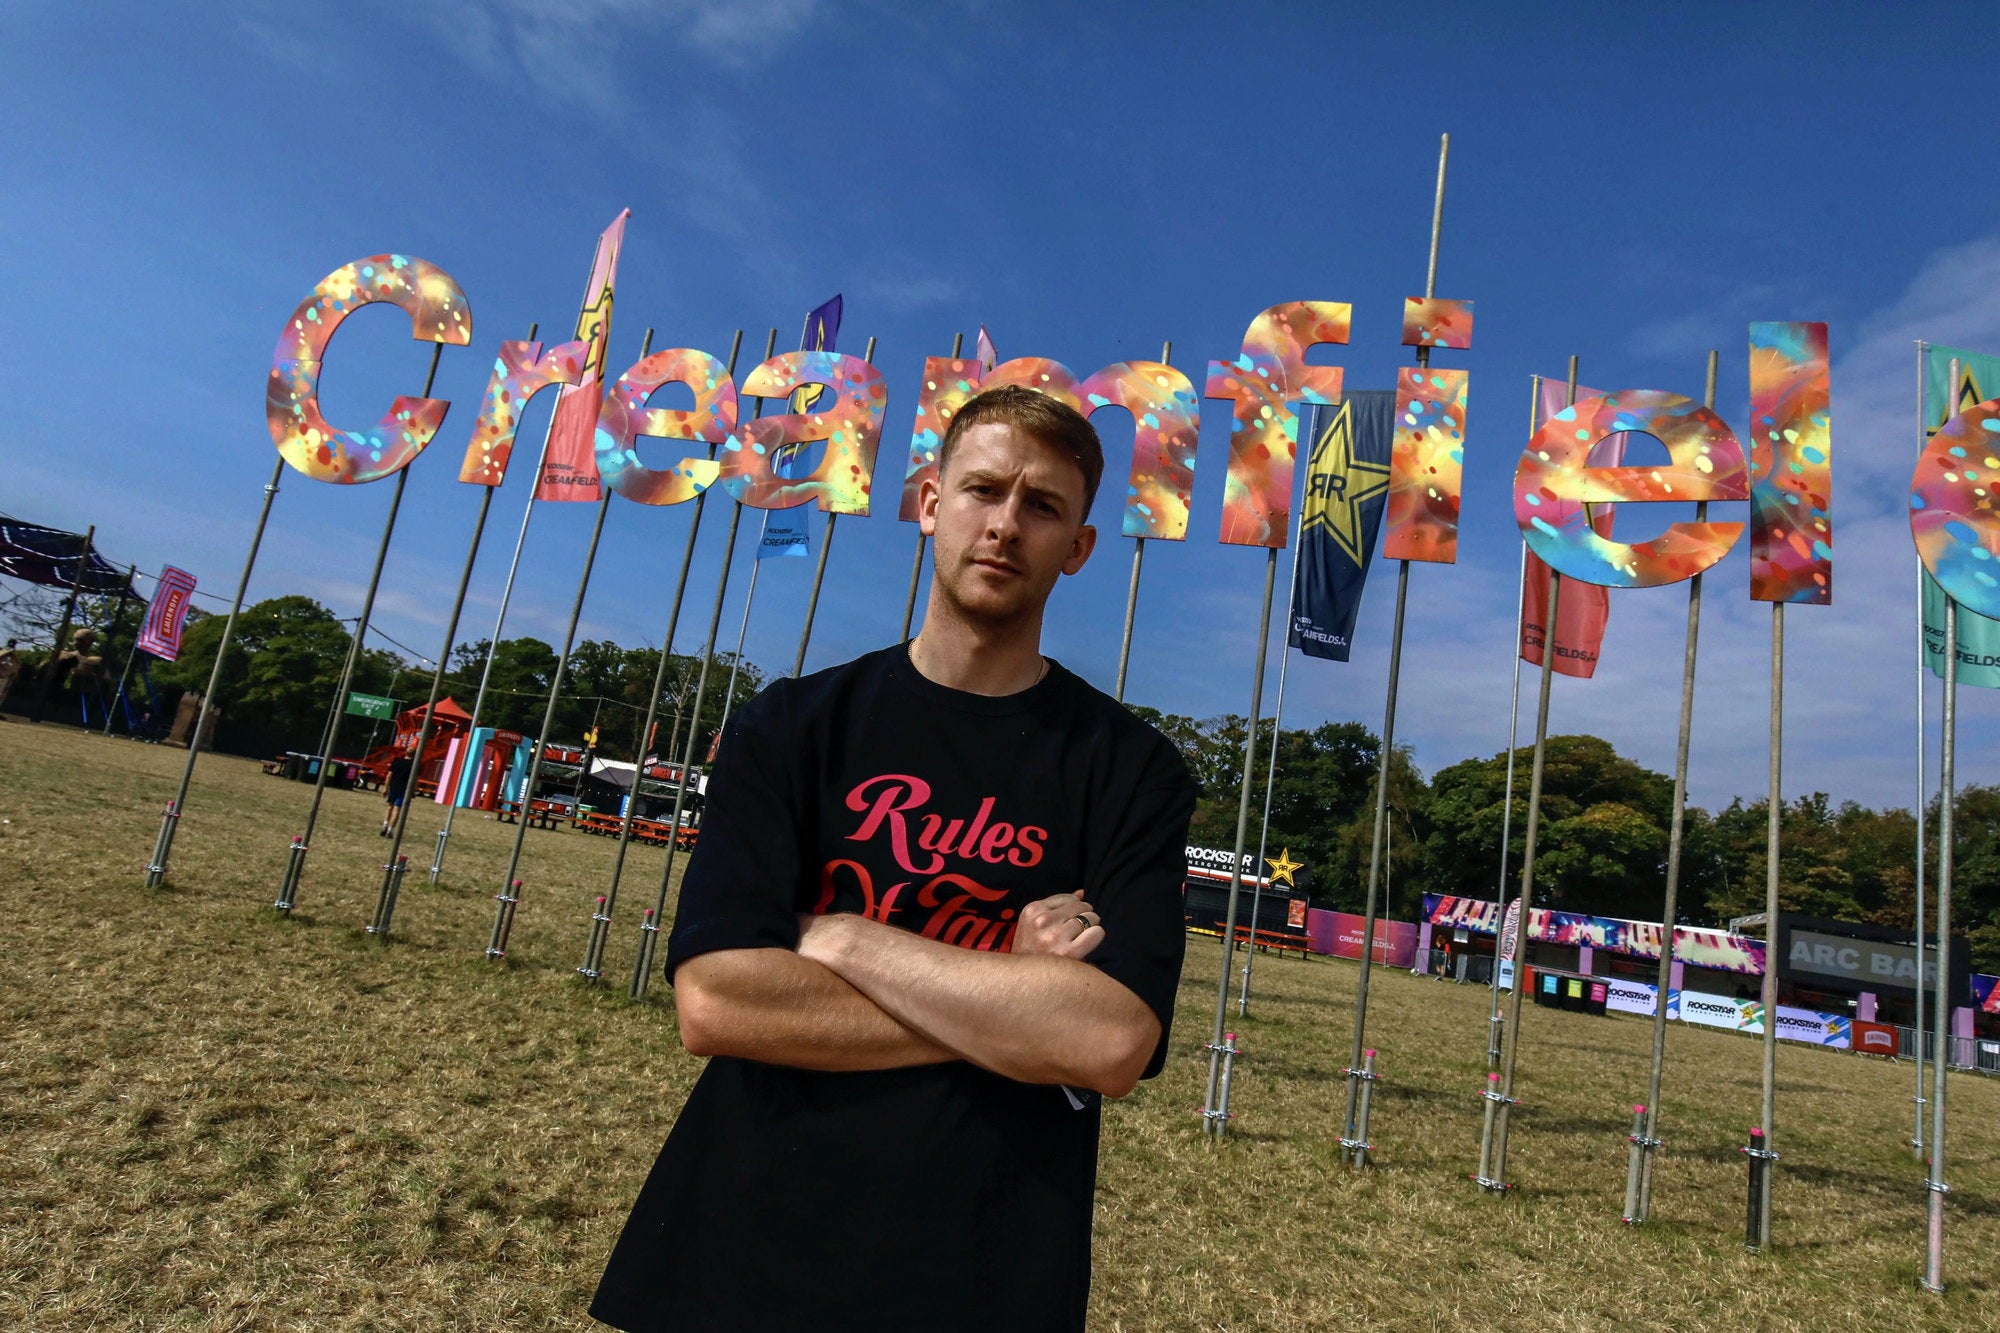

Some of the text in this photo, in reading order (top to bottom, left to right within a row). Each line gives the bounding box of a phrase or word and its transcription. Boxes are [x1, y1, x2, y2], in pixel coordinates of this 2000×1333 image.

[1294, 622, 1340, 645] CAMFIELDS
[1524, 634, 1588, 661] CREFIELDS
[844, 773, 1049, 875] Rules
[1184, 846, 1255, 867] ROCKSTR
[1188, 860, 1251, 874] NERGY DRK
[1788, 940, 1938, 983] ARC BAR
[1687, 1000, 1736, 1015] ROCKSTAR
[1776, 1016, 1822, 1030] ROCKSTAR
